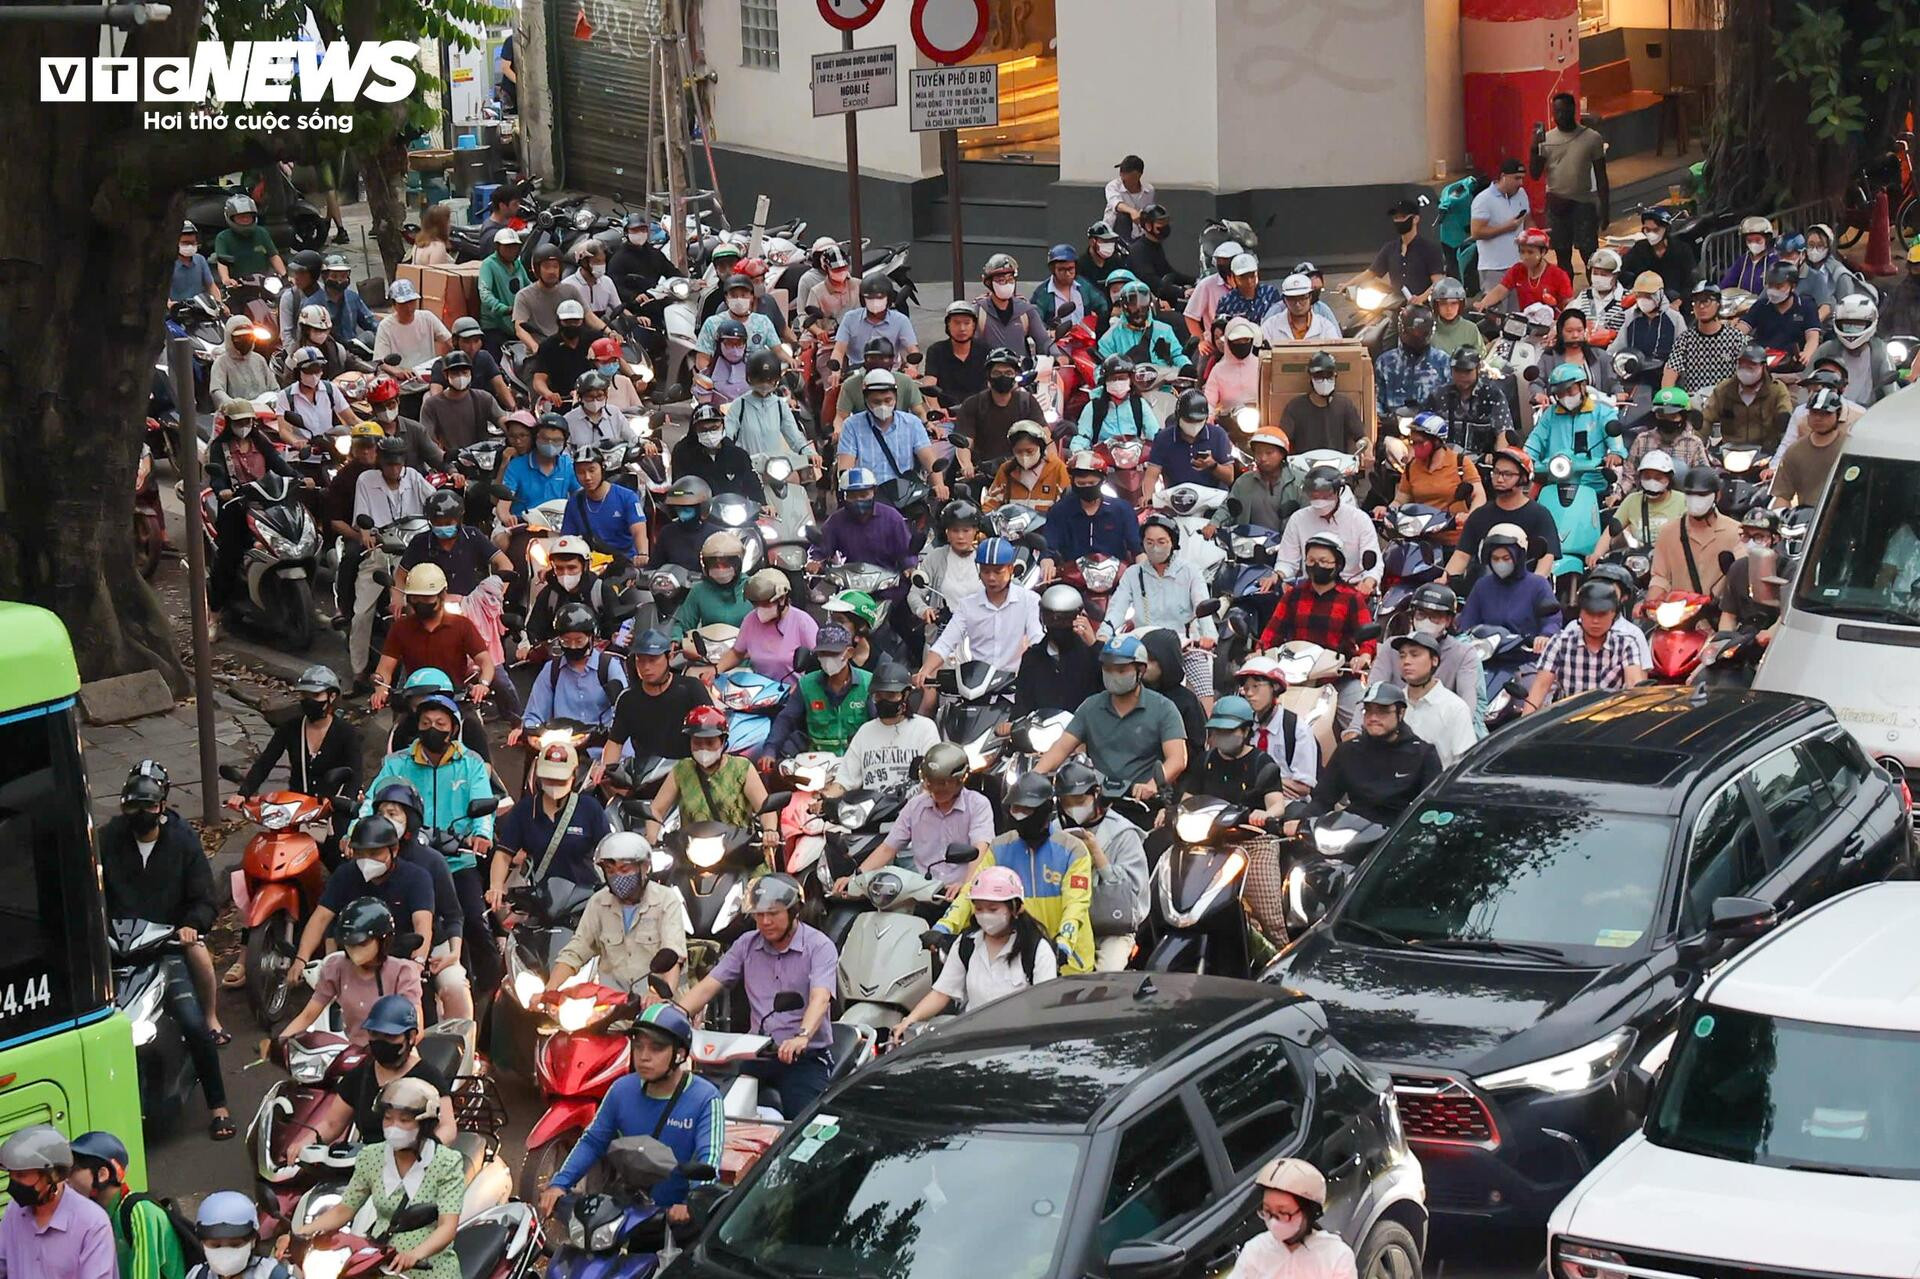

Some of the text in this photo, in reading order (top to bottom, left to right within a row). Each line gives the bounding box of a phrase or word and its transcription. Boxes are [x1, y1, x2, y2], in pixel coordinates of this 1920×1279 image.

[916, 71, 944, 88] TUYẾN
[948, 69, 967, 85] PHỐ
[980, 69, 992, 85] BỘ
[840, 84, 860, 96] NGOẠI
[842, 97, 868, 108] Except
